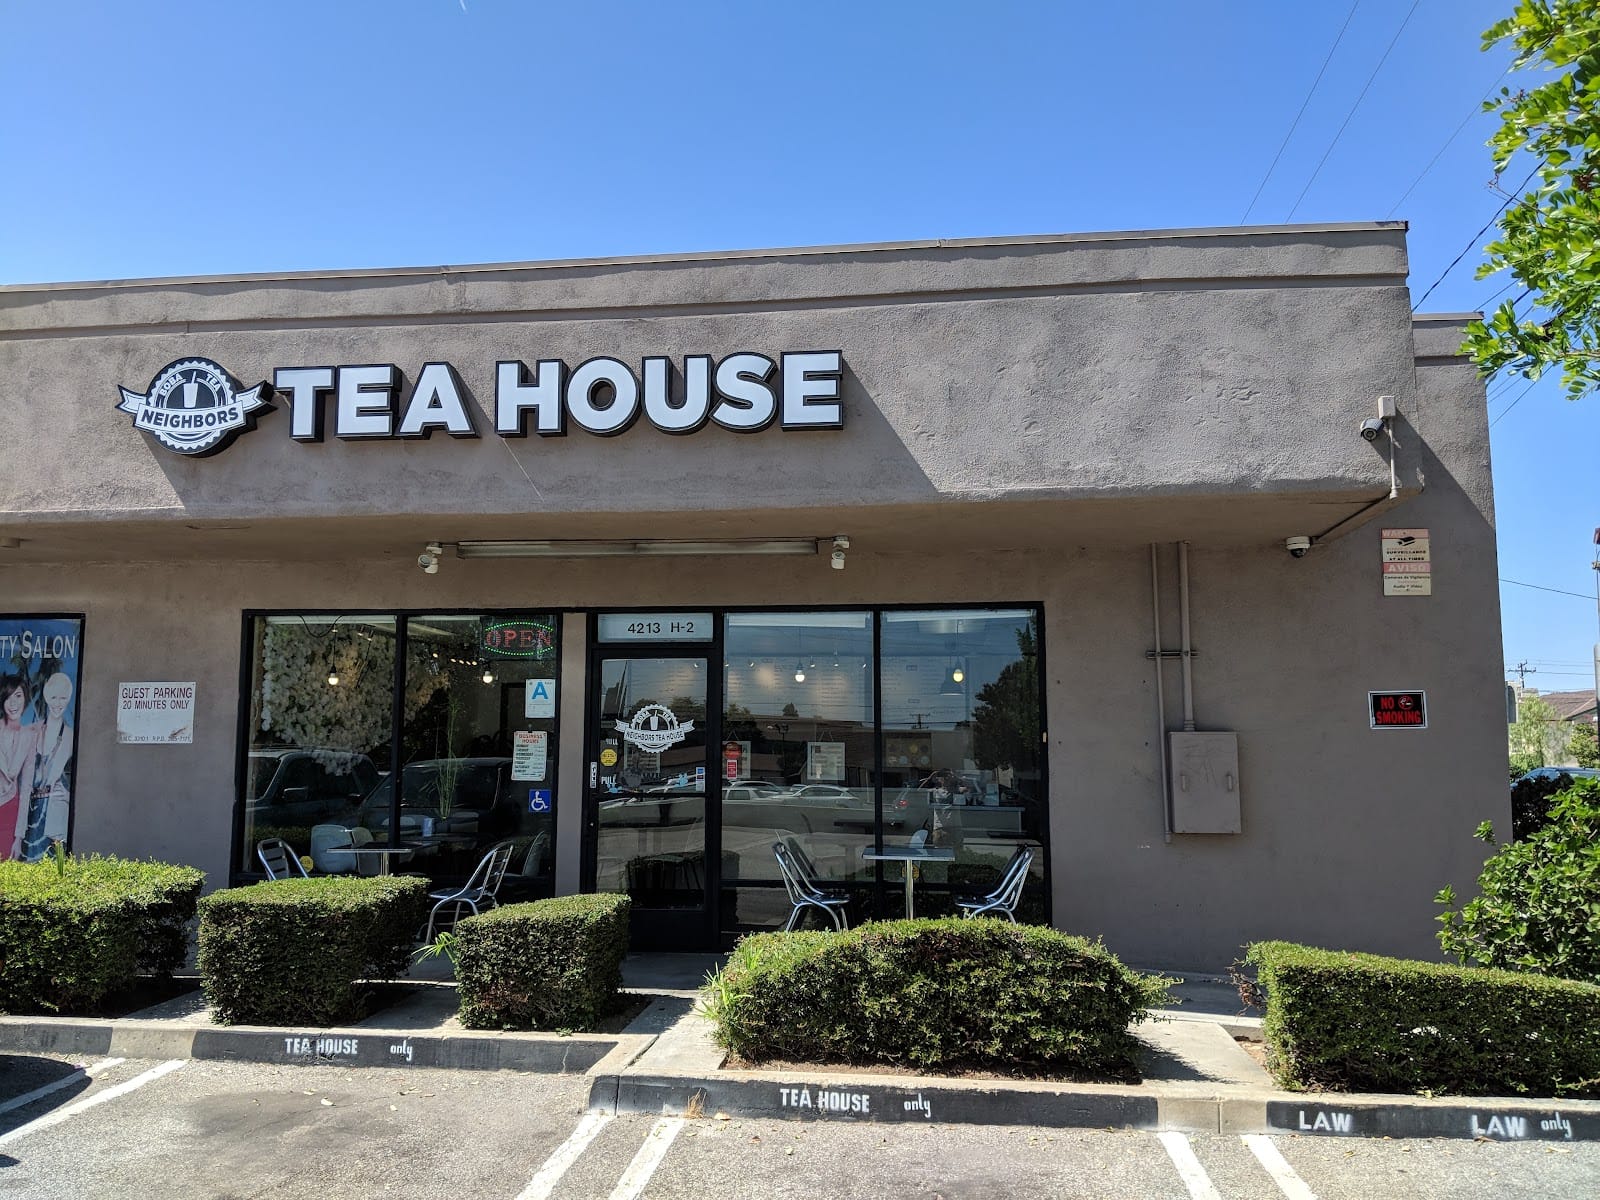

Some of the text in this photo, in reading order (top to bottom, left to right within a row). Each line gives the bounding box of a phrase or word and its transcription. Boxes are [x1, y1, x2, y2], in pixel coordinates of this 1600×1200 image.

[159, 373, 222, 396] BOBA TEA
[274, 350, 844, 439] TEA HOUSE
[140, 406, 239, 429] NEIGHBORS
[1388, 564, 1426, 572] AVISO
[486, 629, 551, 648] OPEN
[627, 621, 694, 634] 4213 H-2
[121, 687, 193, 699] GUEST PARKING
[531, 680, 549, 700] A
[122, 699, 190, 710] 20 MINUTES ONLY
[1375, 696, 1422, 724] NO SMOKING
[625, 731, 655, 742] NEIGHBORS
[667, 731, 684, 740] HOUSE
[284, 1037, 413, 1061] TEA HOUSE only
[779, 1088, 931, 1118] TEA HOUSE only
[1299, 1110, 1351, 1132] LAW
[1471, 1112, 1572, 1138] LAW only
